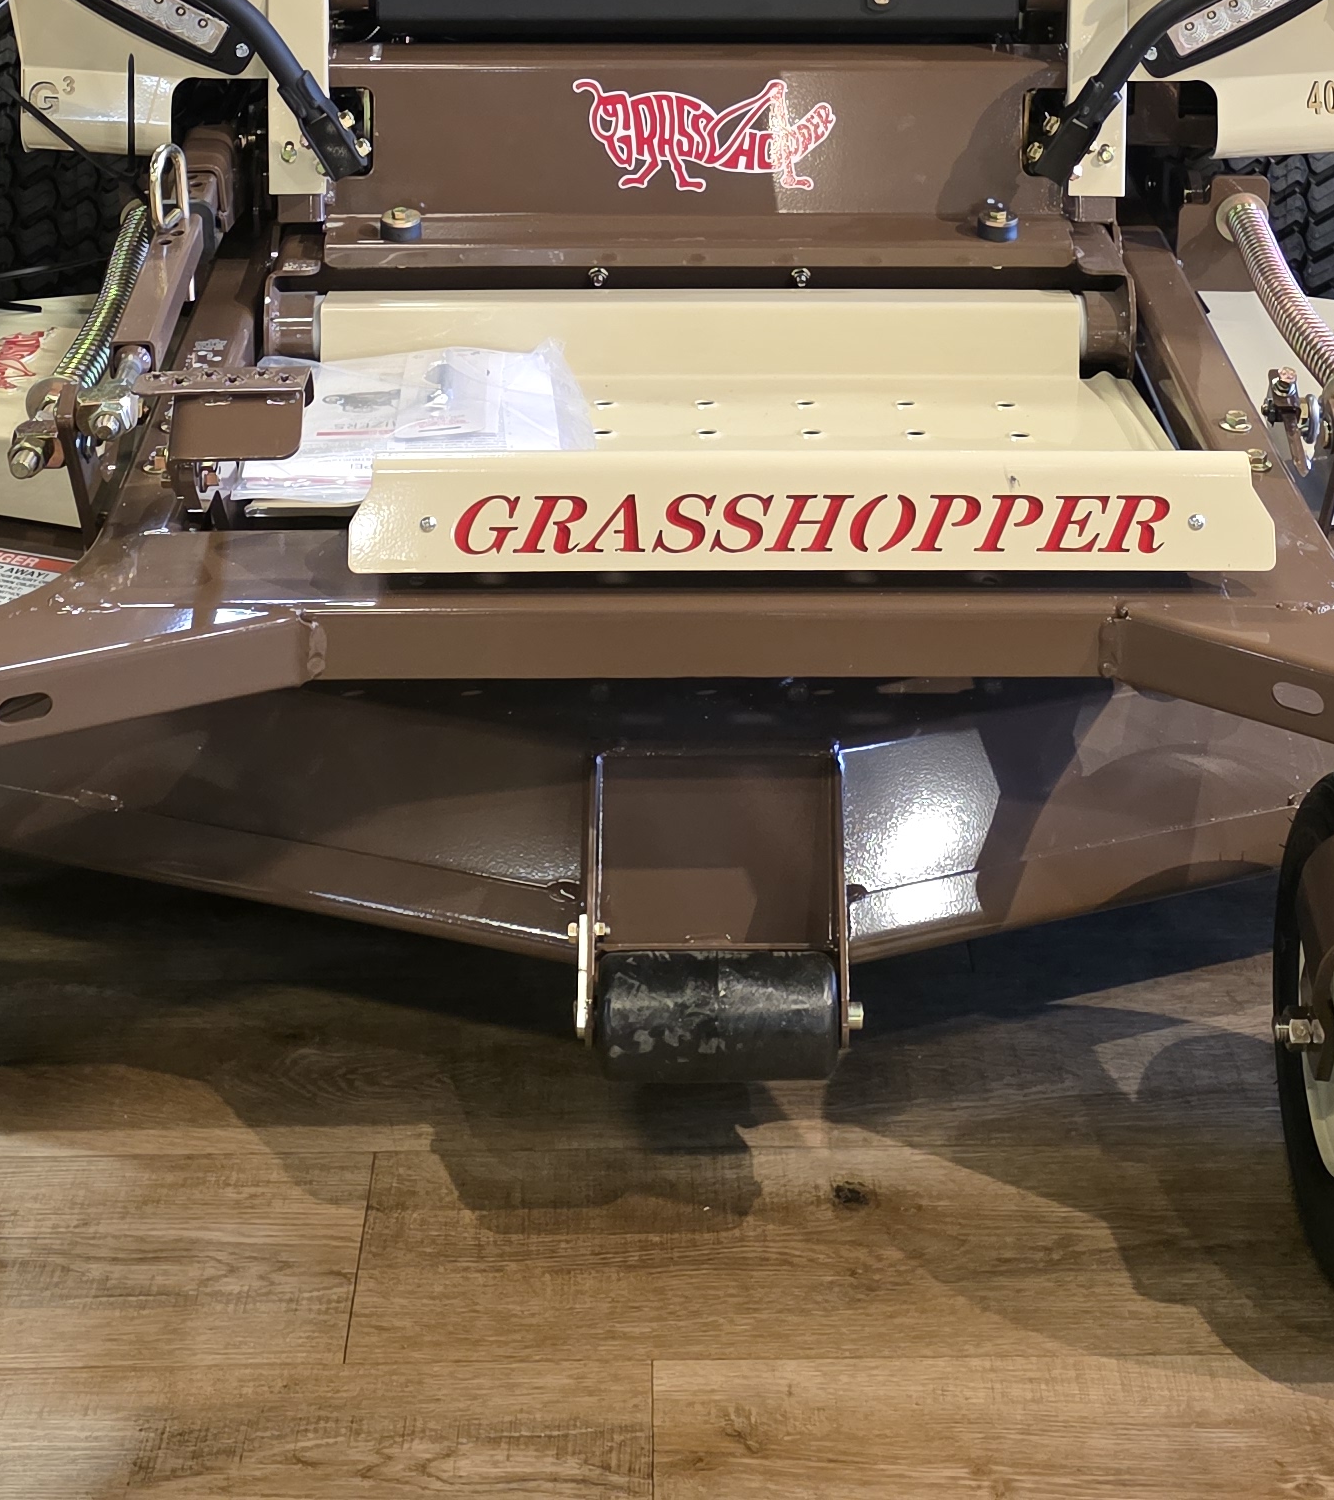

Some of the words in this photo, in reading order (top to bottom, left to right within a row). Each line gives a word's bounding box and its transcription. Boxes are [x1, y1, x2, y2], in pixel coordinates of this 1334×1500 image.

[601, 88, 835, 177] GRASSHOPPER
[450, 493, 1172, 554] GRASSHOPPER
[7, 566, 50, 580] AWAY!
